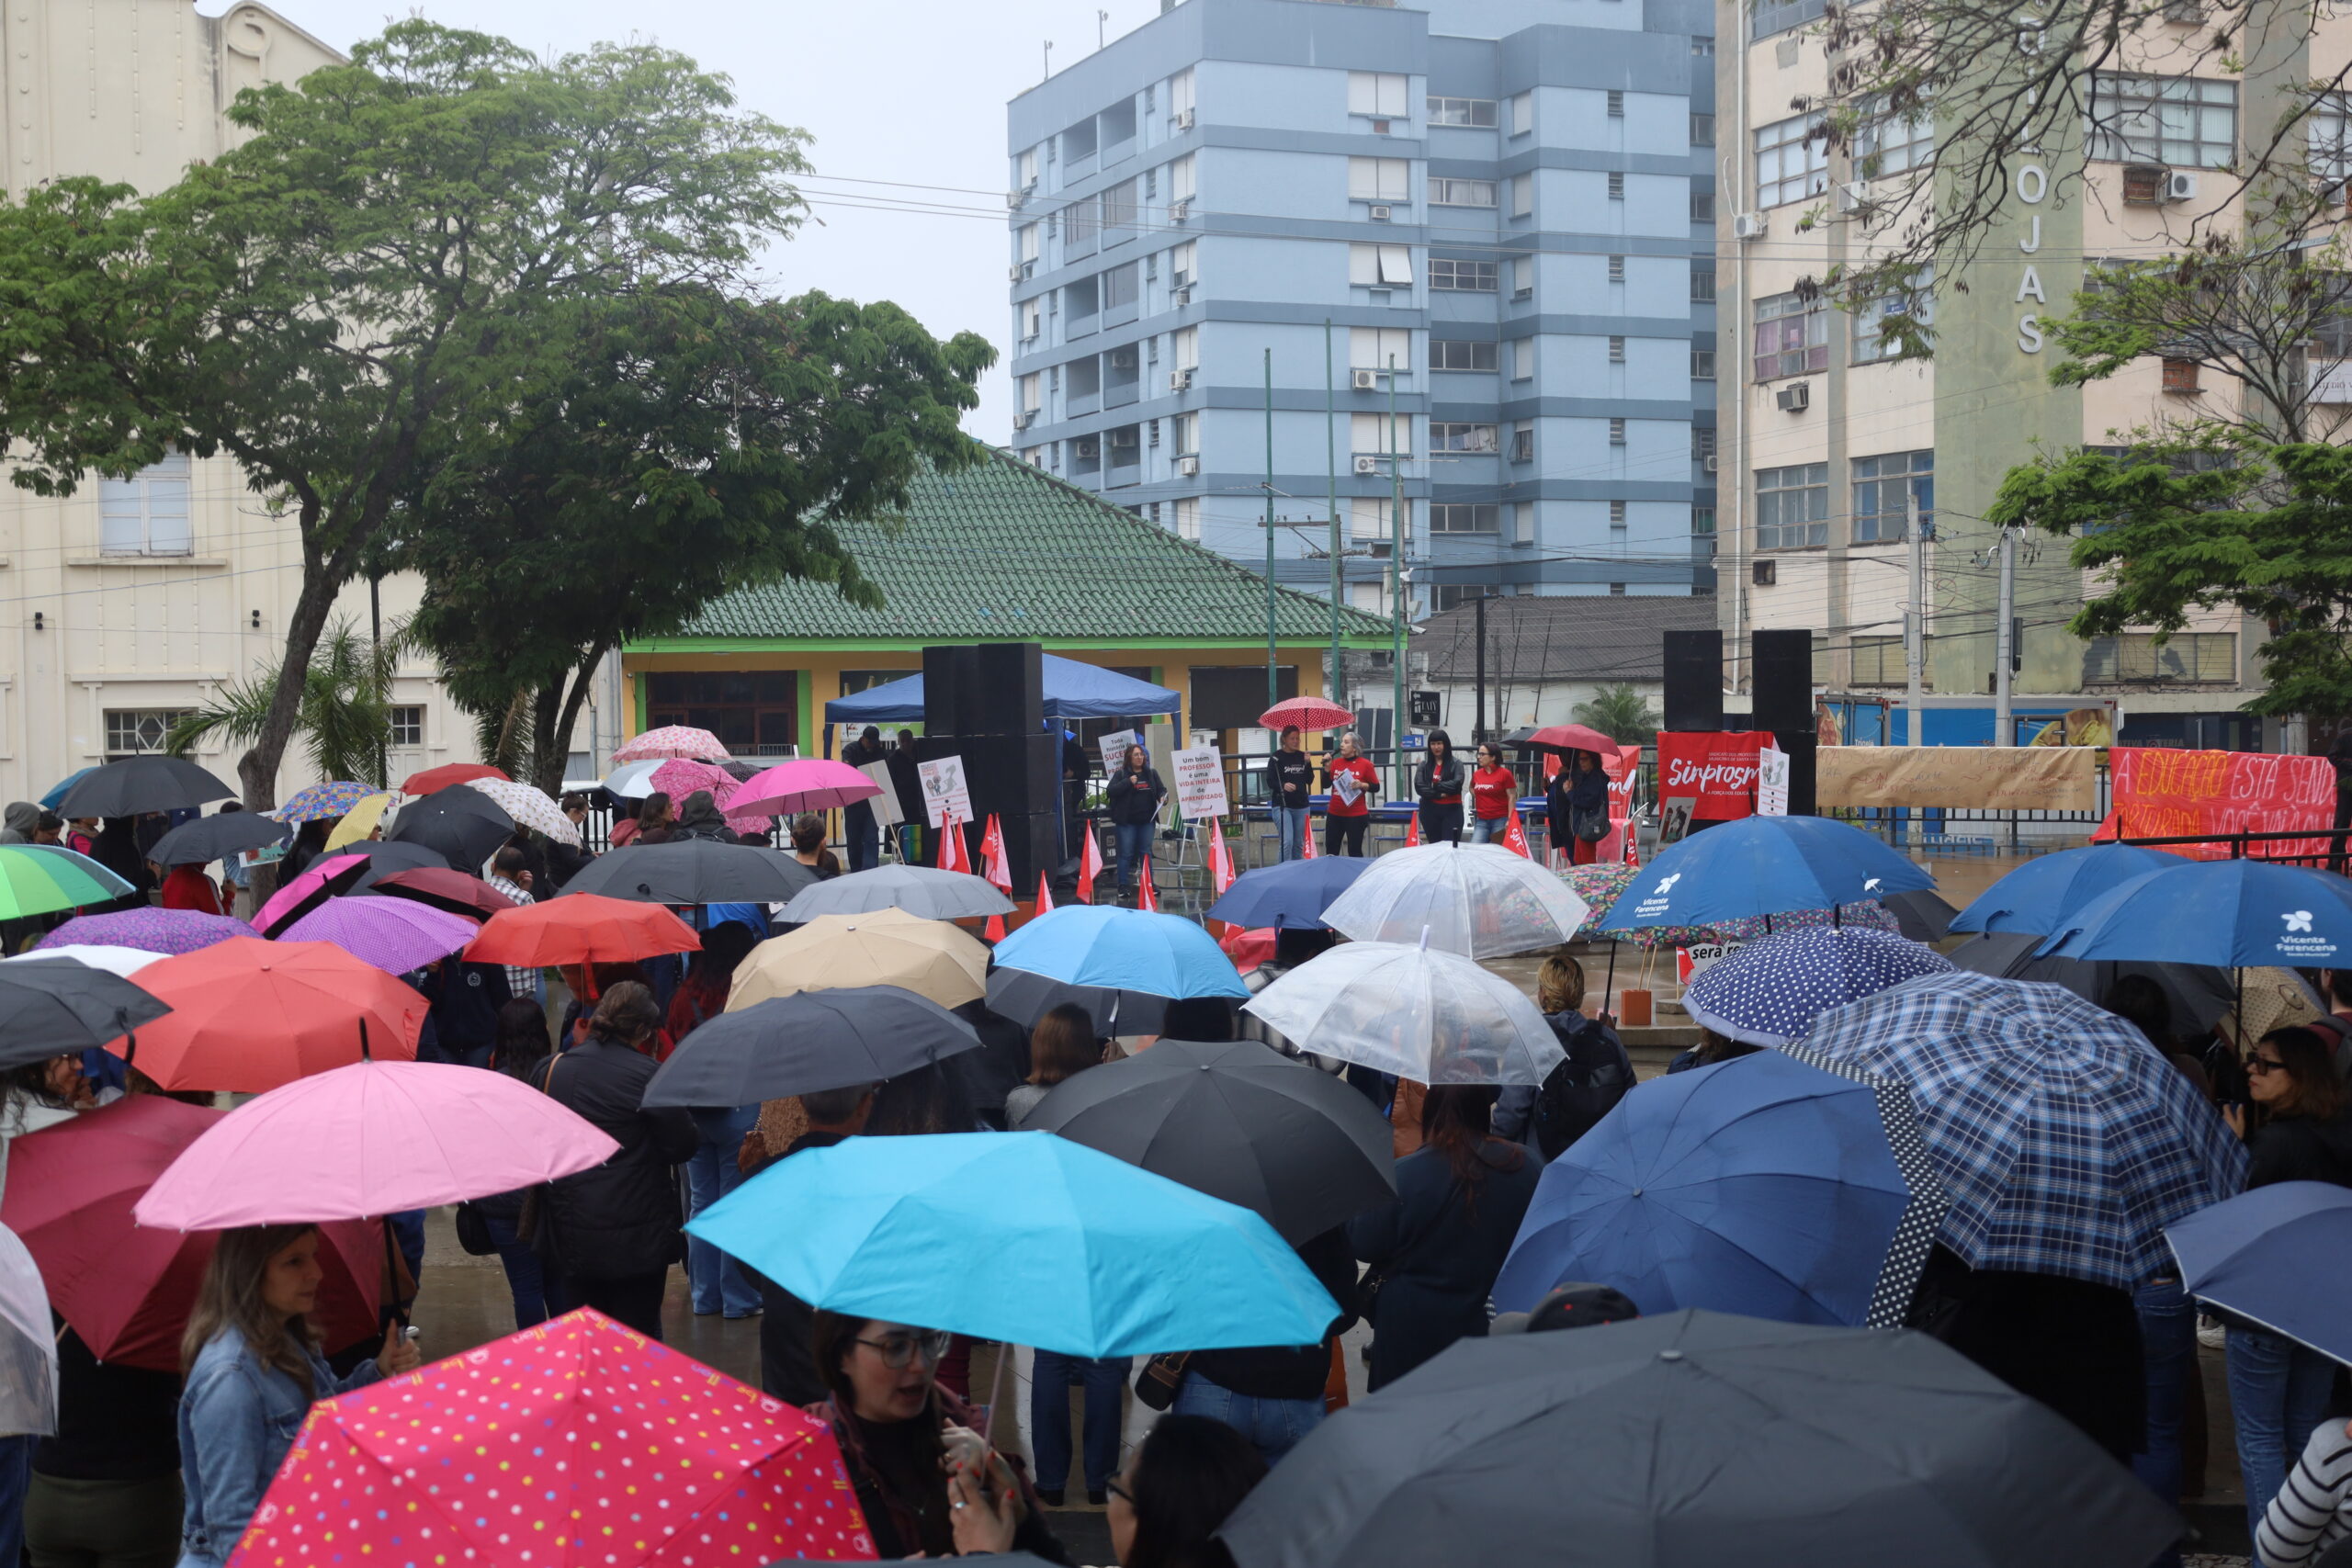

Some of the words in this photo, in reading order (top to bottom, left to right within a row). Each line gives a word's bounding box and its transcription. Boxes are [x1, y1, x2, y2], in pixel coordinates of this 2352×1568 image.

[1179, 762, 1216, 771] PROFESSOR
[2113, 751, 2131, 795] A
[2136, 749, 2228, 803] EDUCAÇÃO
[2230, 754, 2284, 799] ESTÁ
[1181, 793, 1224, 802] APRENDIZADO
[1643, 897, 1668, 906] Vicente
[1634, 904, 1669, 913] Farencena
[2280, 935, 2326, 944] Vicente
[2276, 942, 2337, 952] Farencena
